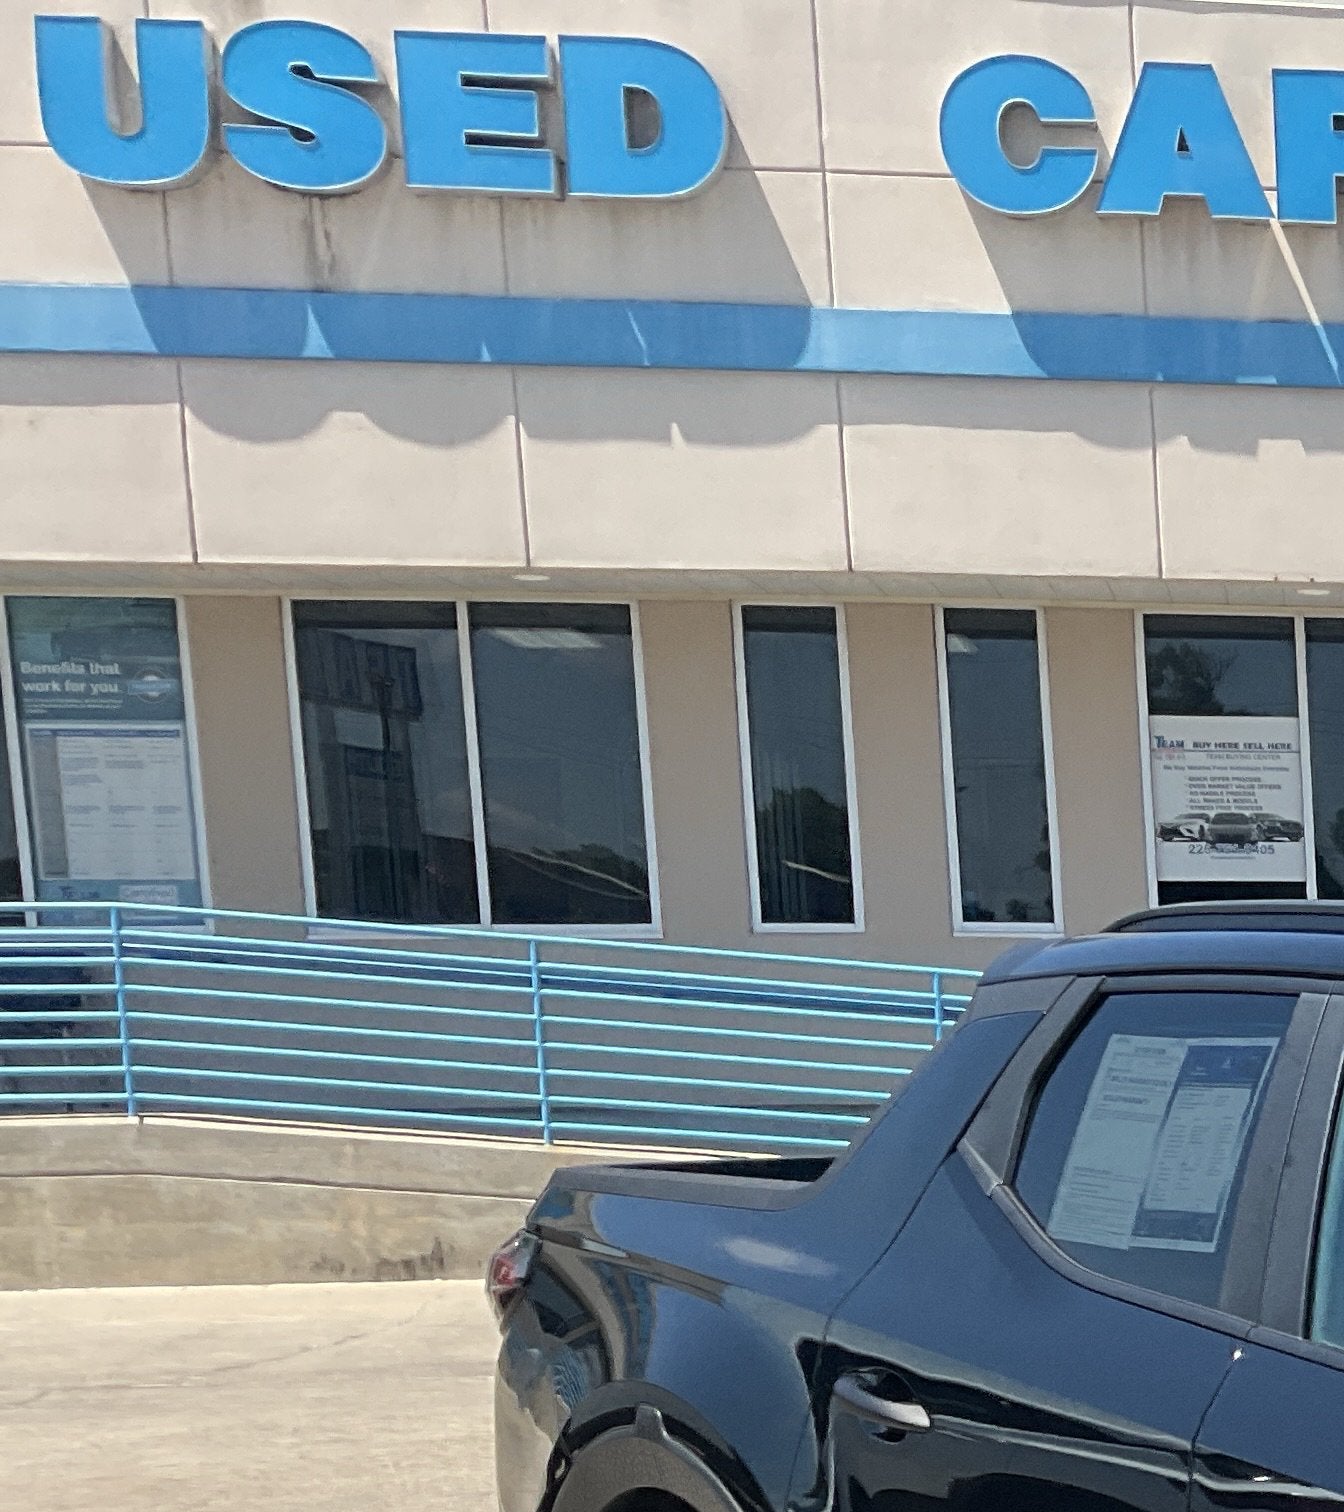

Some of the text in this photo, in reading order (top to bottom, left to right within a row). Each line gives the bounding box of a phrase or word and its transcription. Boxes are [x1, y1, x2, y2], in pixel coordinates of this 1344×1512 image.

[34, 14, 729, 200] USED
[20, 661, 120, 675] Benefits that
[22, 680, 61, 692] work
[64, 680, 86, 692] for
[1192, 741, 1292, 750] BUY HERE SELL HERE
